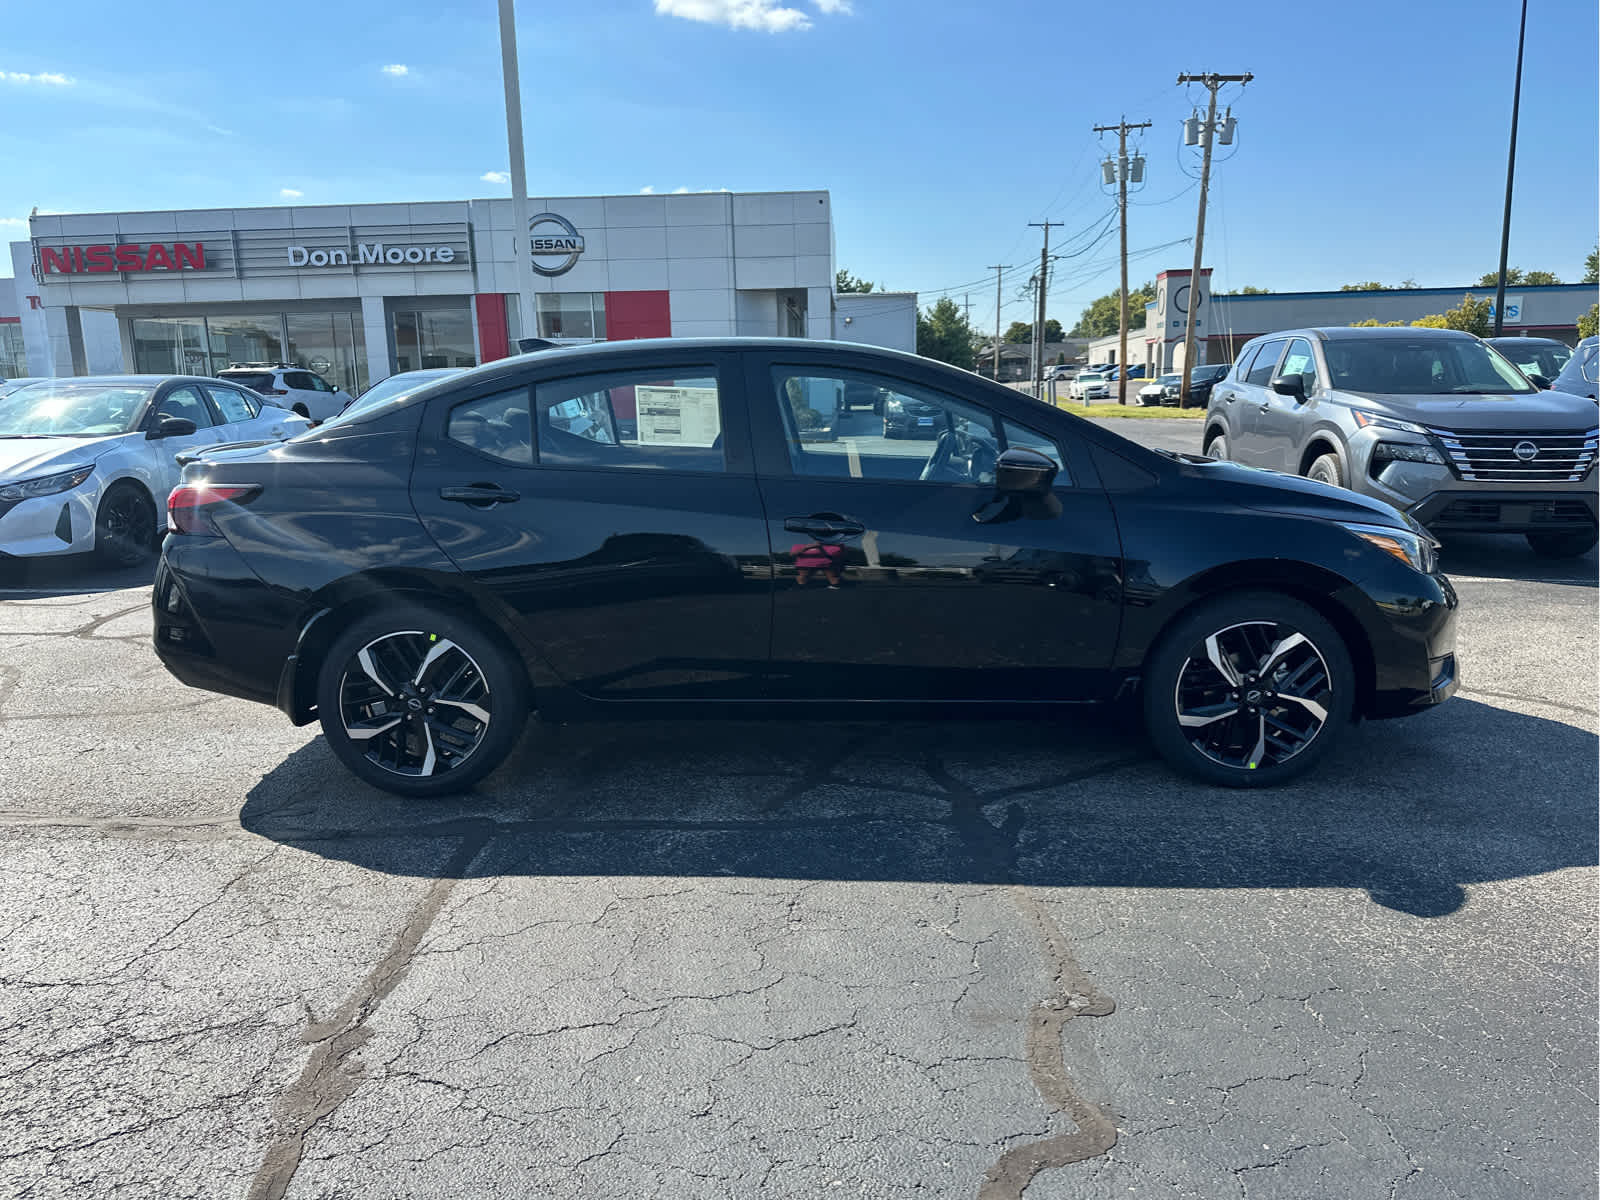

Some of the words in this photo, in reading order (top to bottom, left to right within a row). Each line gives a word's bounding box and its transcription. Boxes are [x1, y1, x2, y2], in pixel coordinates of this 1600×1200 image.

[287, 246, 347, 267] Don
[358, 243, 455, 264] Moore
[530, 239, 576, 249] ISSAN
[41, 243, 205, 273] NISSAN
